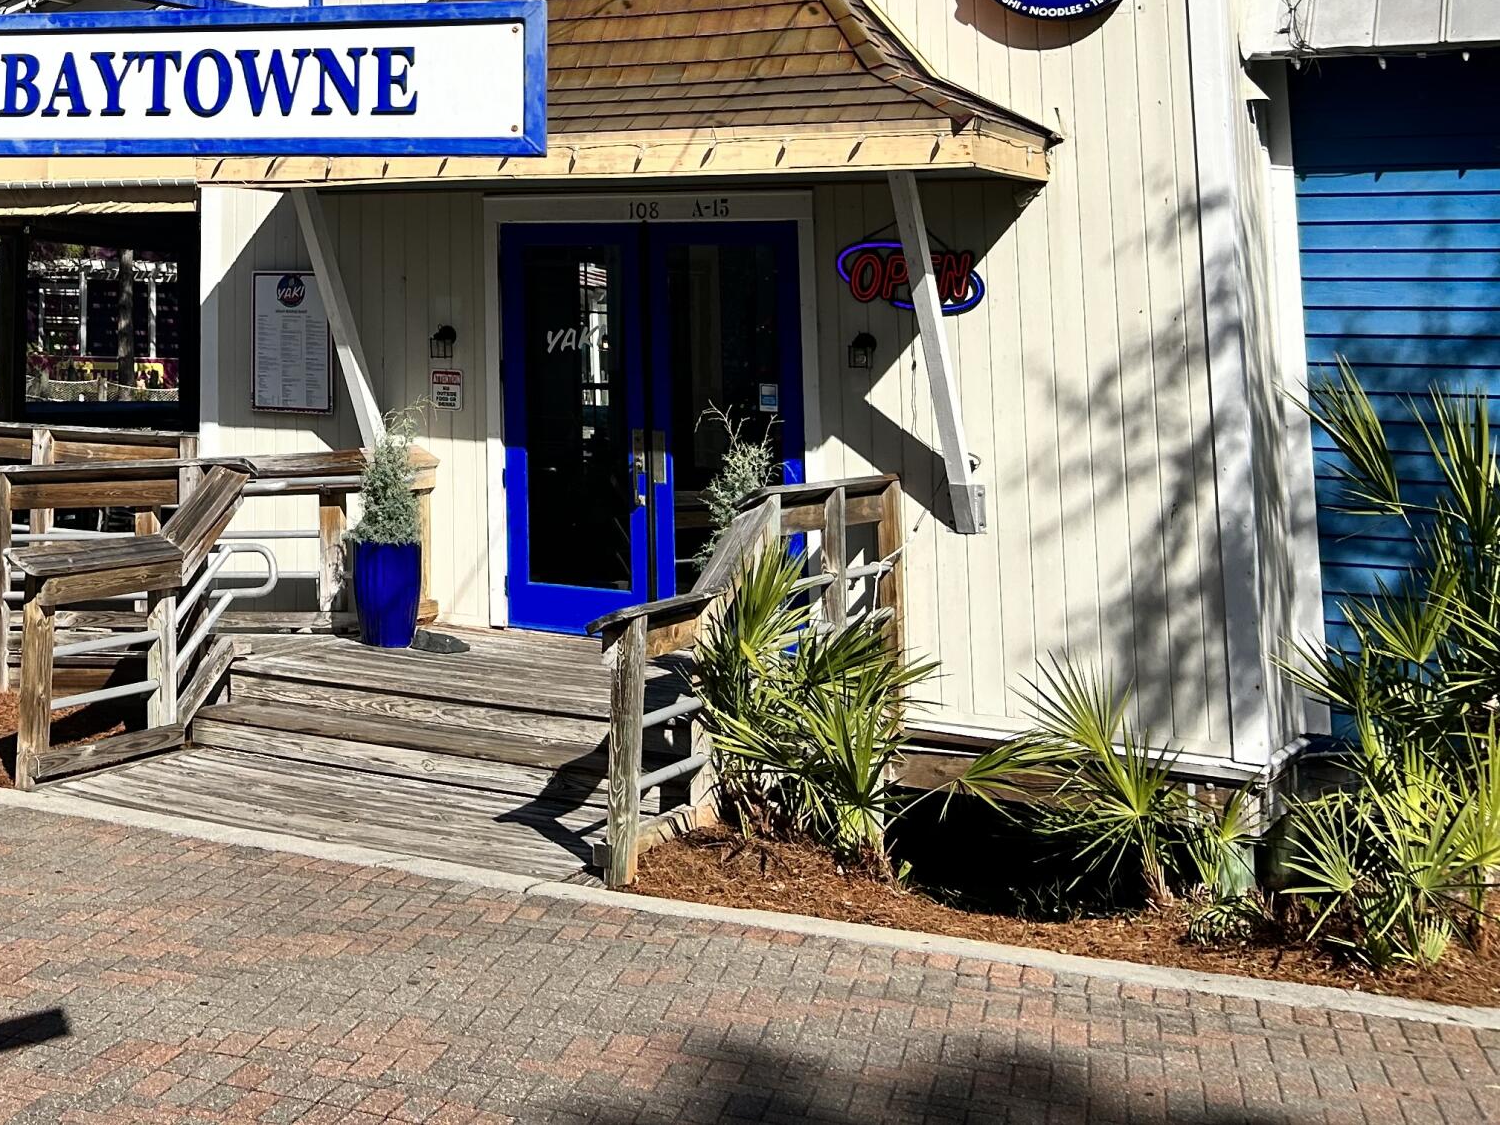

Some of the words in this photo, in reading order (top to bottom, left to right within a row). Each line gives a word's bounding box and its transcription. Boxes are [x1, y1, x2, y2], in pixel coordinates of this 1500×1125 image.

[1028, 3, 1084, 18] NOODLES
[628, 201, 660, 220] 108
[691, 198, 730, 218] A-15
[850, 252, 973, 302] OPN
[277, 285, 305, 300] YAKI
